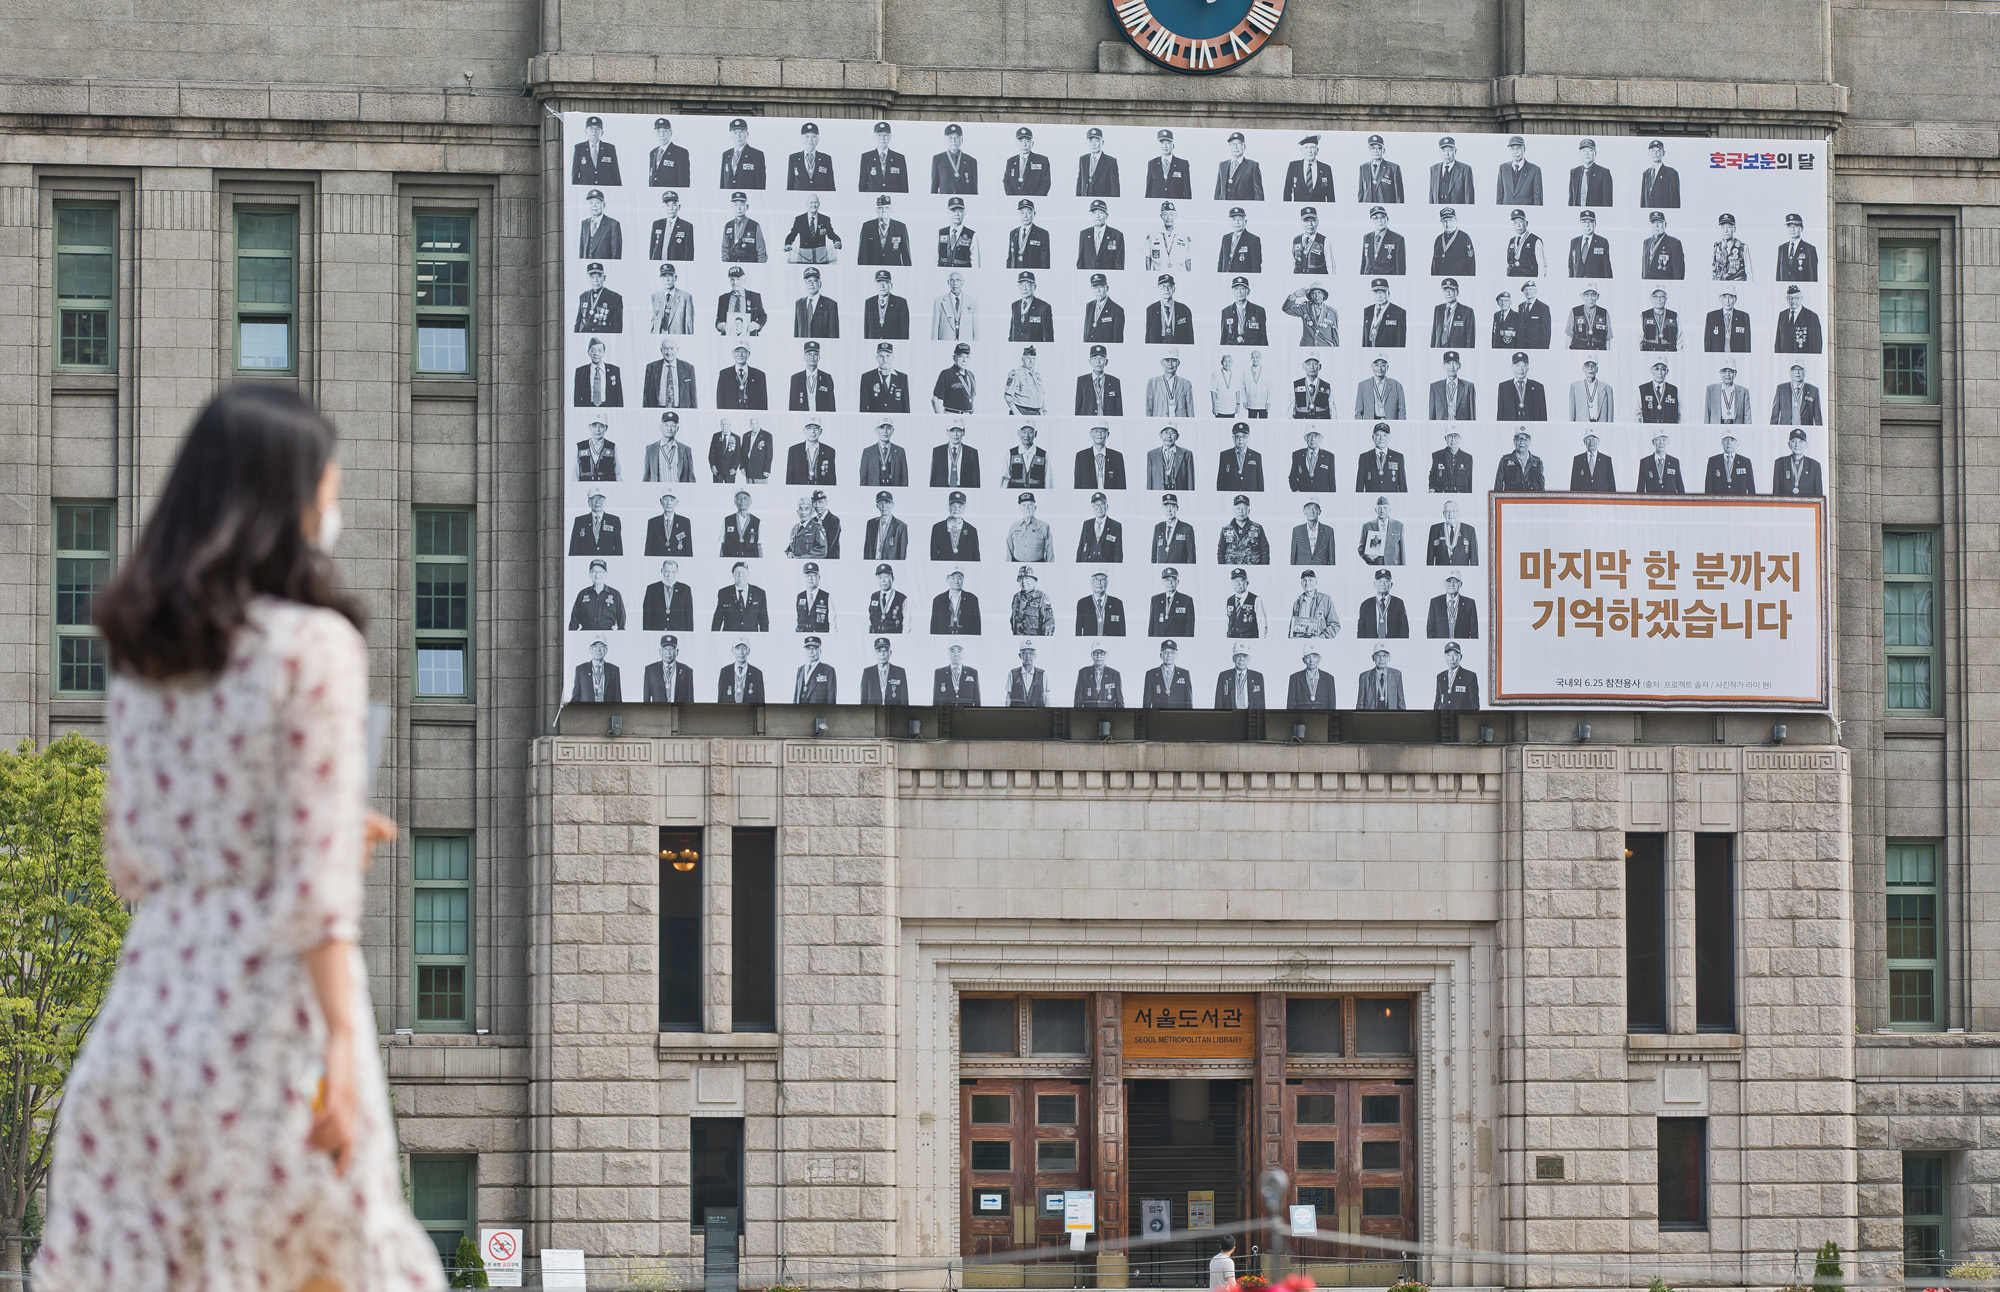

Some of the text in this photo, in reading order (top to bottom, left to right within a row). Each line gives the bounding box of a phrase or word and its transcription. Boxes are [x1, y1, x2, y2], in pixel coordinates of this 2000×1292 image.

[1710, 152, 1815, 170] 호국보훈의 달
[1519, 548, 1800, 592] 마지막 한 분까지
[1531, 596, 1793, 640] 기억하겠습니다
[1556, 678, 1582, 688] 국내외
[1584, 678, 1604, 688] 6.25
[1605, 678, 1640, 689] 참전용사
[1664, 680, 1692, 689] 프로젝트
[1715, 681, 1744, 690] 사진작가
[1134, 1008, 1243, 1029] 서울도서관
[1149, 1205, 1164, 1213] 입구
